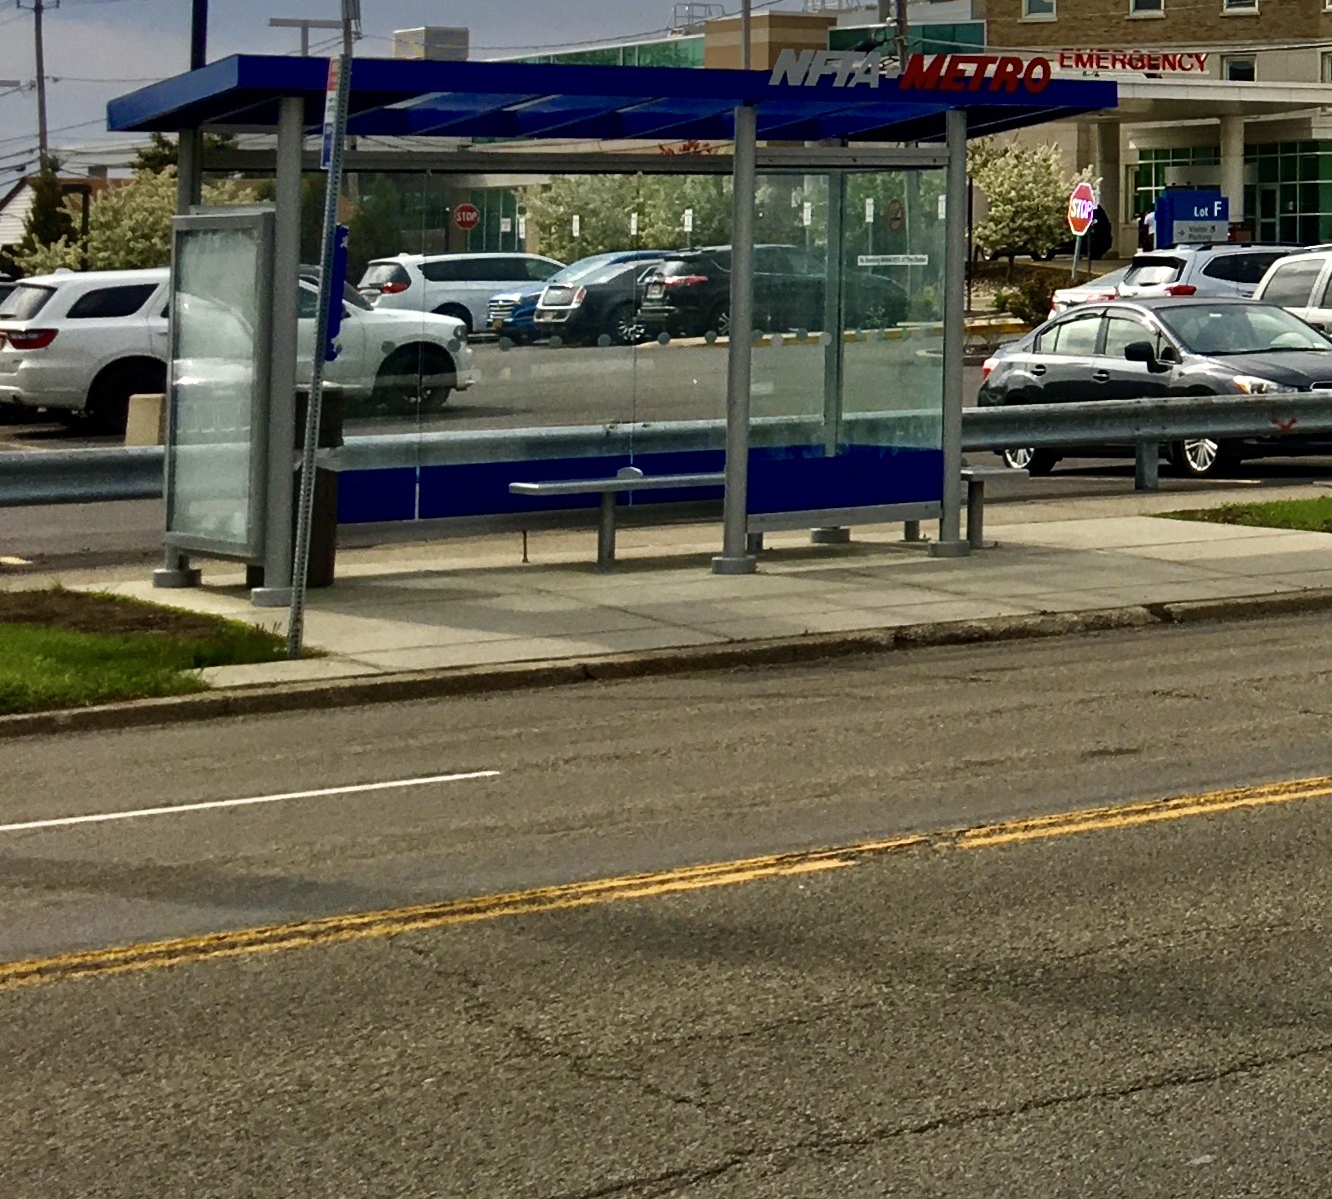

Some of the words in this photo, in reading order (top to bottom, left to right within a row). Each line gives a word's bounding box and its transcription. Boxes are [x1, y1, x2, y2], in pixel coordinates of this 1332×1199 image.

[1059, 48, 1209, 73] EMERGENCY
[456, 211, 478, 222] STOP
[1070, 198, 1092, 219] STOP
[1193, 206, 1209, 217] Lot
[1213, 201, 1222, 217] F
